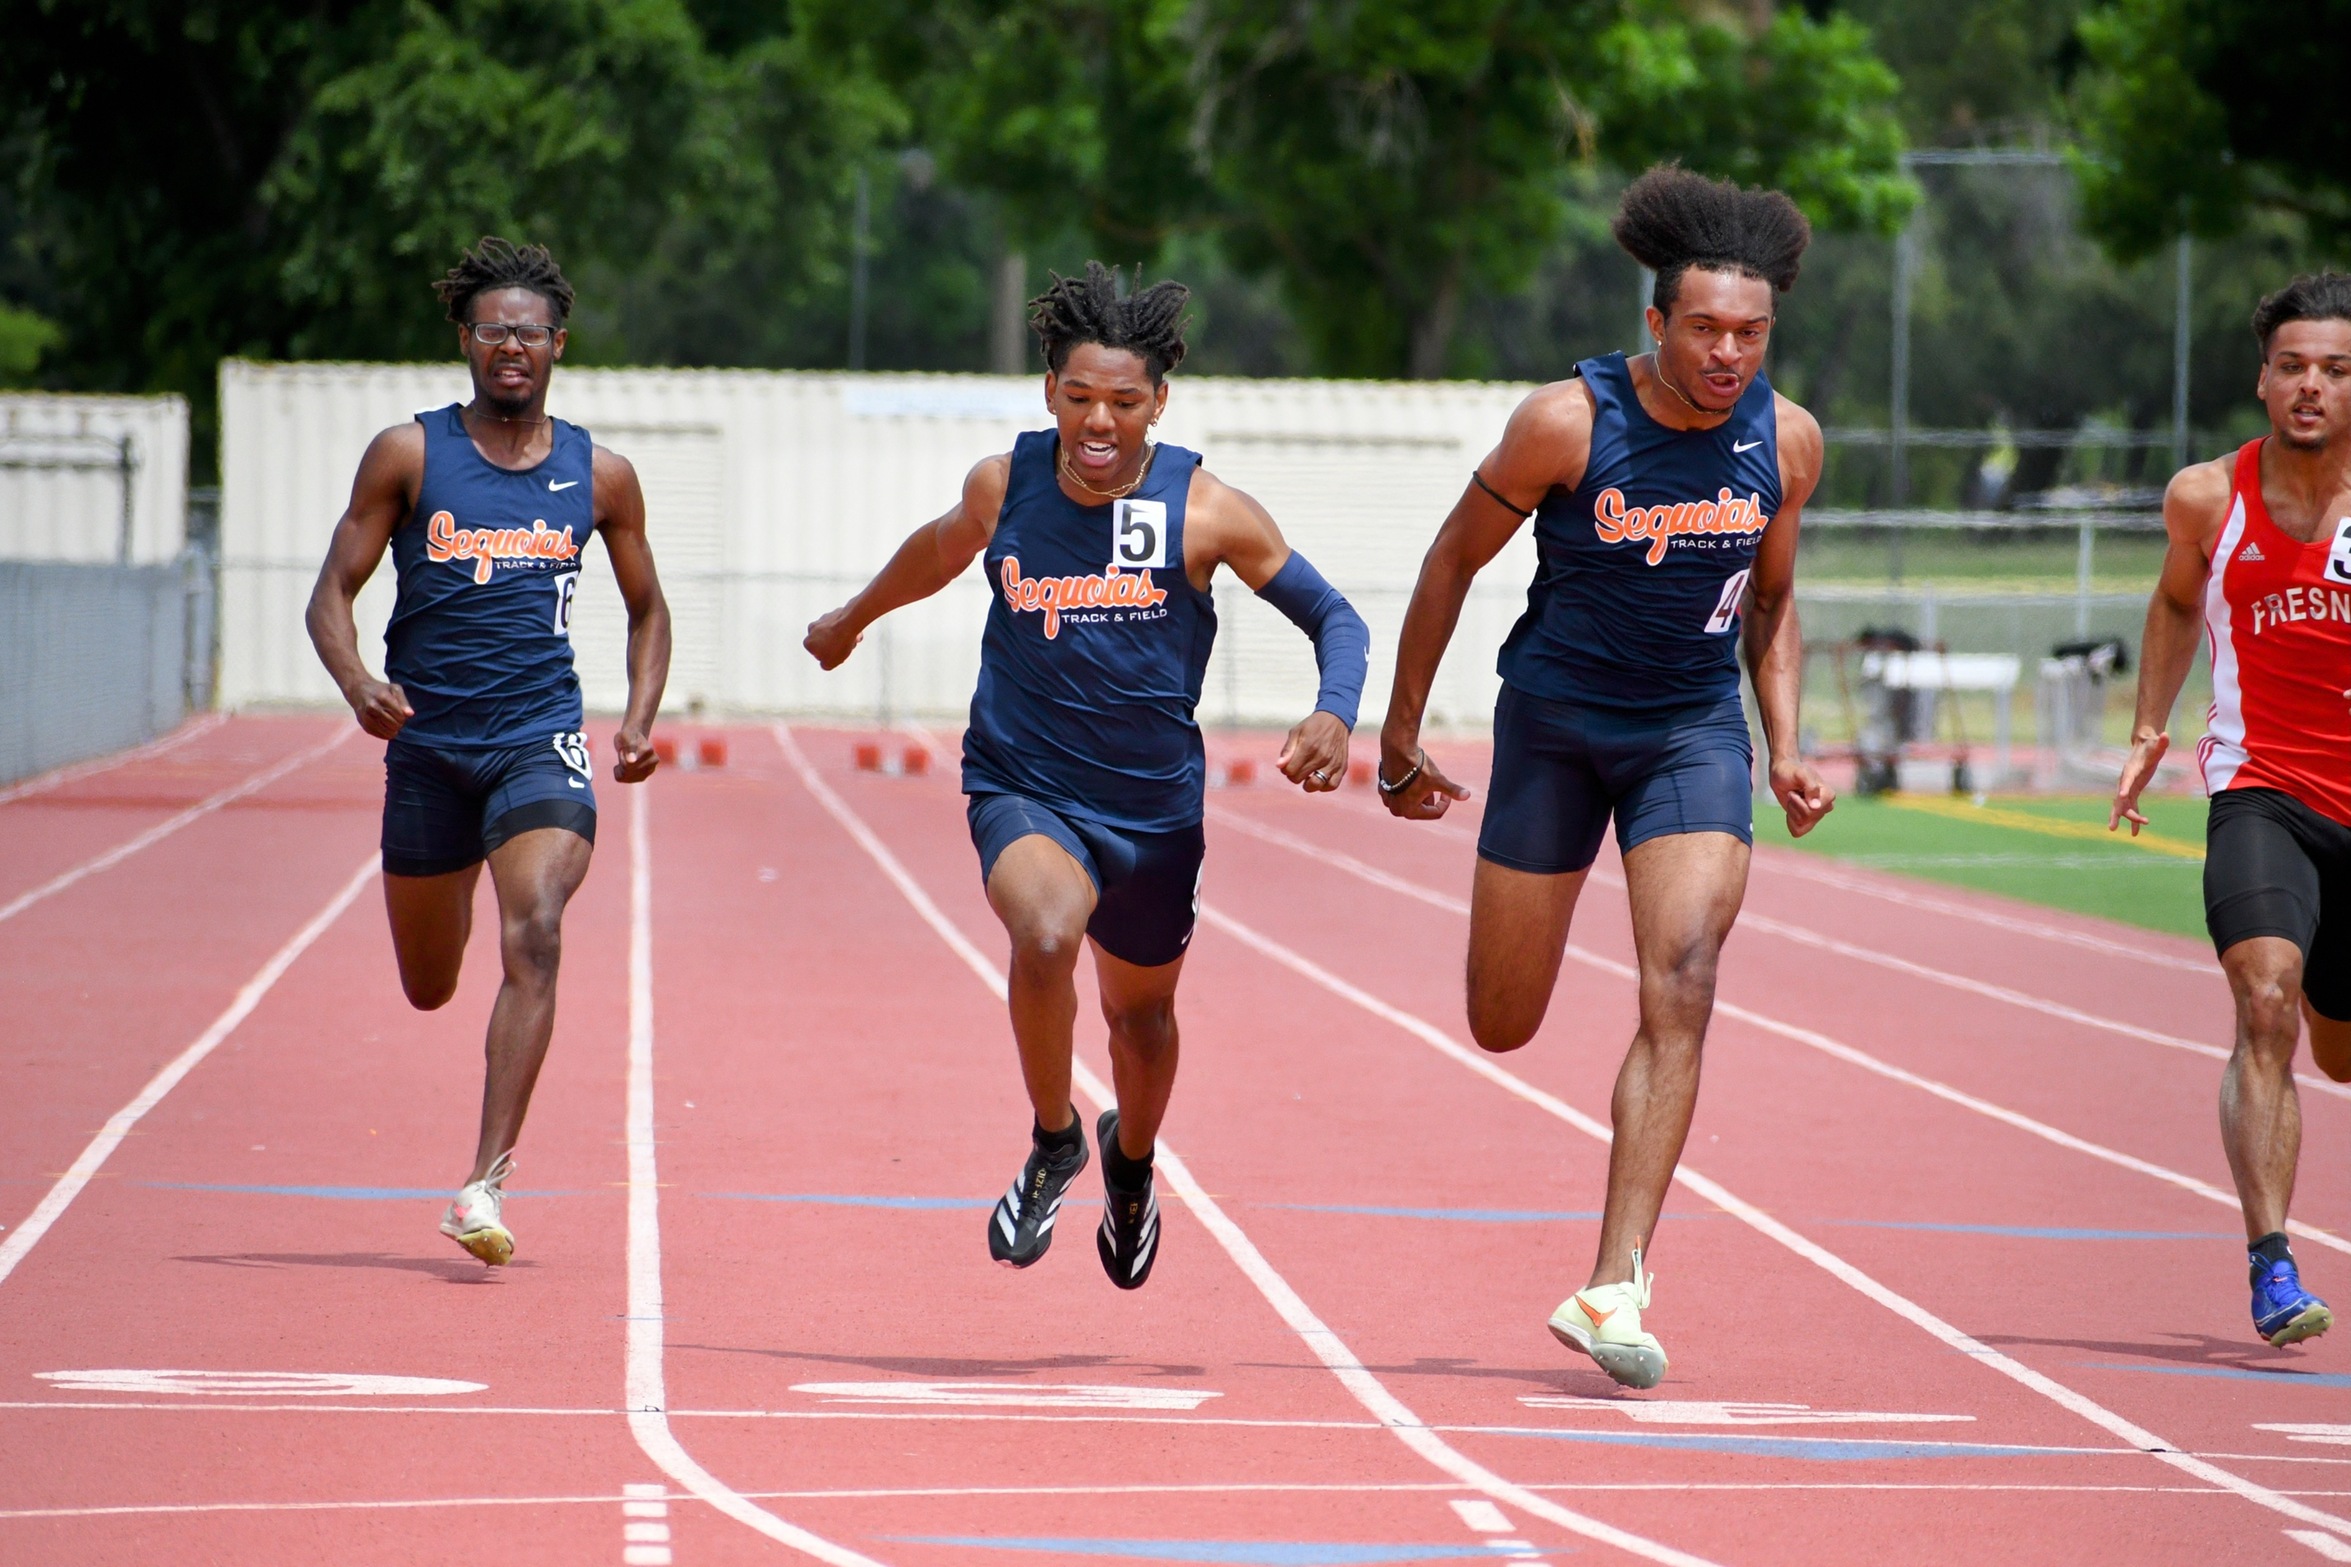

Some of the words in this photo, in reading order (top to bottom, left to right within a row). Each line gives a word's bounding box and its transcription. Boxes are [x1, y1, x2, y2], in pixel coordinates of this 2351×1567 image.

[426, 510, 579, 585] Sequoias
[1120, 504, 1156, 562] 5
[1594, 487, 1769, 566] Sequoias
[1671, 540, 1717, 549] TRACK
[1722, 540, 1731, 549] &
[1736, 535, 1762, 547] FIELD
[495, 561, 535, 570] TRACK
[539, 561, 546, 569] &
[1000, 556, 1168, 640] Sequoias
[1061, 613, 1109, 623] TRACK
[1114, 613, 1124, 622] &
[1129, 608, 1168, 621] FIELD
[1716, 574, 1746, 628] 4
